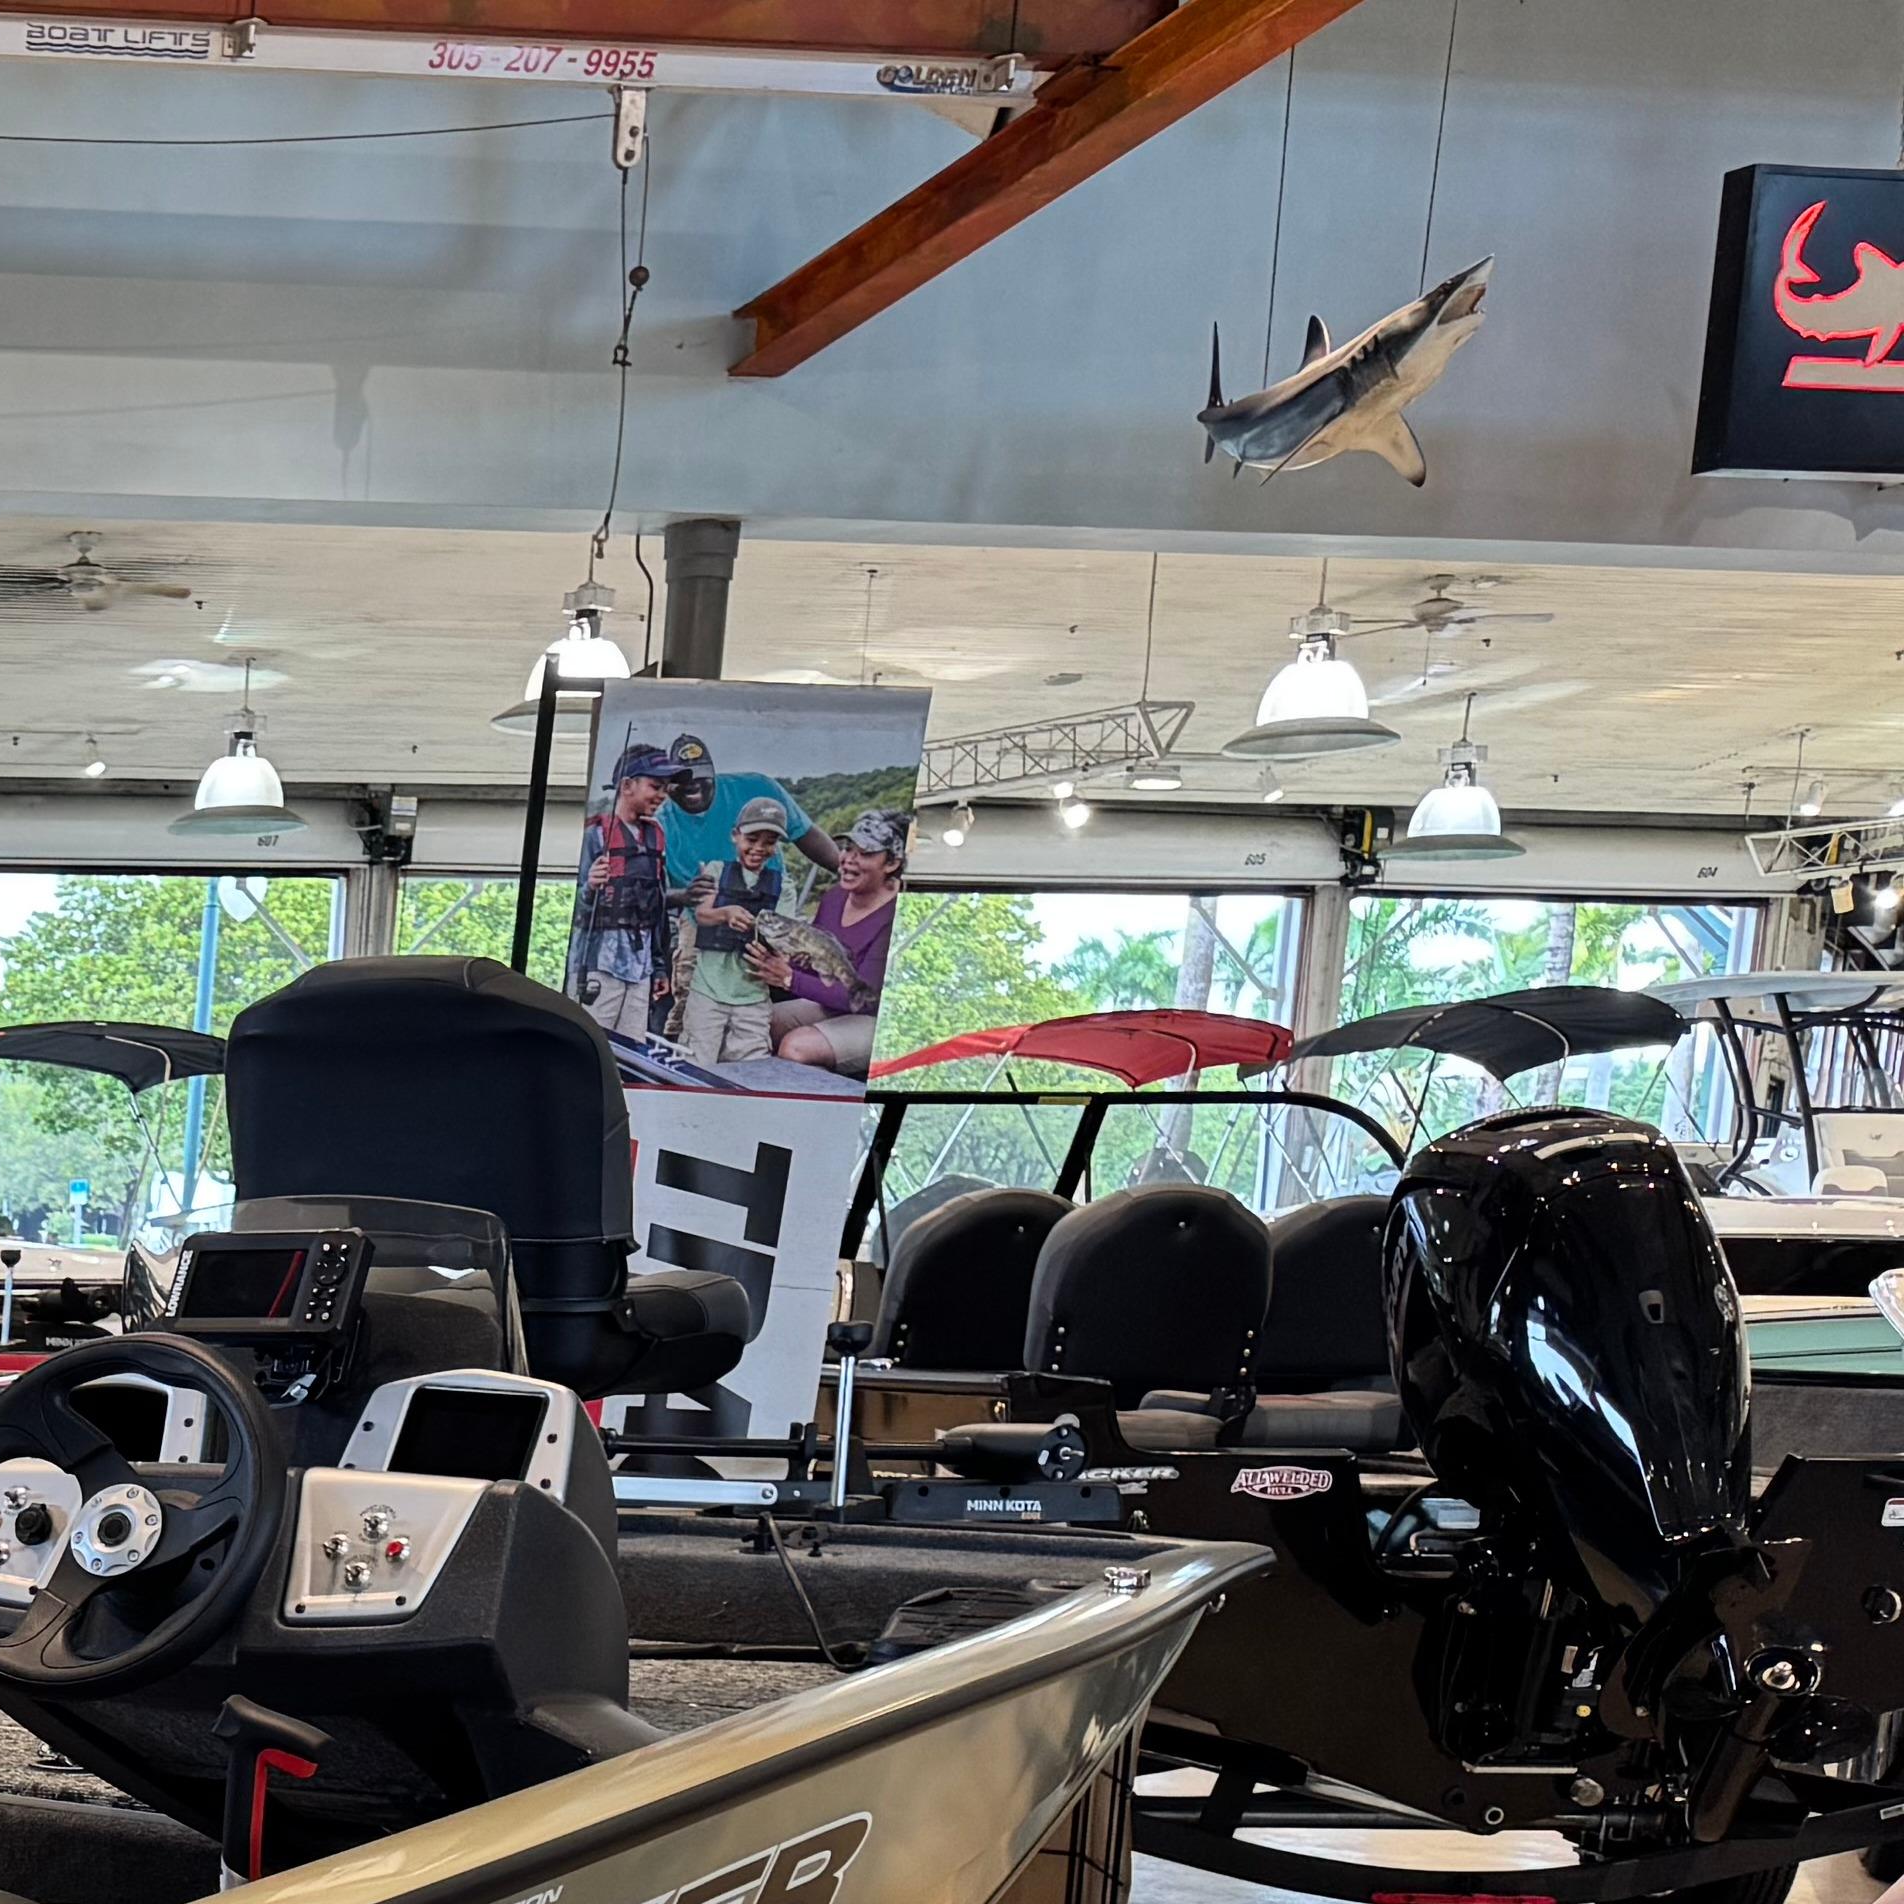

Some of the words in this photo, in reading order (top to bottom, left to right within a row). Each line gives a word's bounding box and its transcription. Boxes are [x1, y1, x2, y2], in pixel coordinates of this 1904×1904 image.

[124, 28, 210, 47] LIFTS
[166, 1250, 193, 1318] LOWRANCE
[967, 1500, 1004, 1512] MINN
[1005, 1500, 1041, 1512] KOTA
